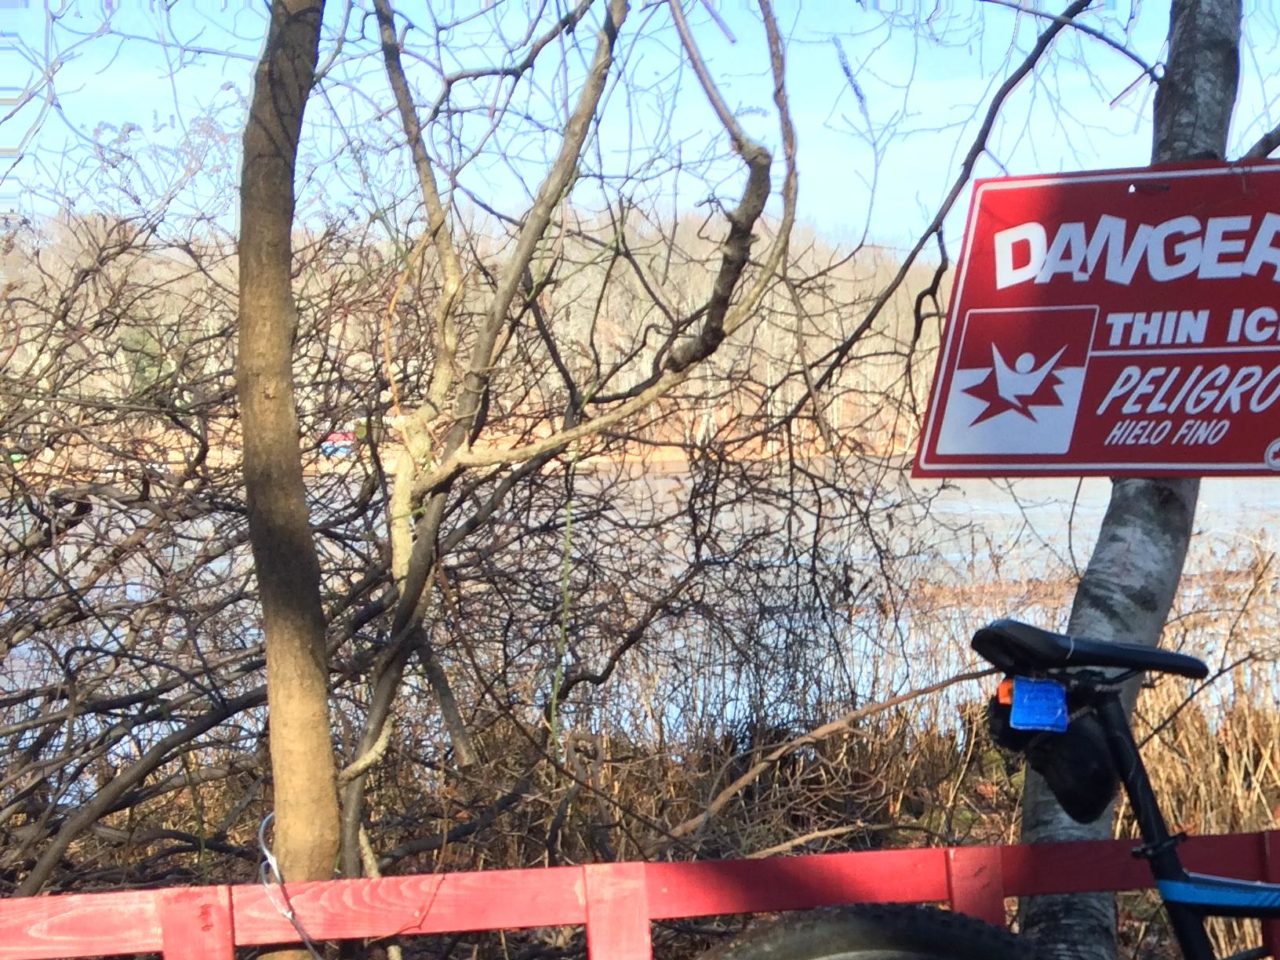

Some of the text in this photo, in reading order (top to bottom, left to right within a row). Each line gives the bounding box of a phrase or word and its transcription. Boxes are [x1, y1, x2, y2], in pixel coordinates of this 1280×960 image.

[1107, 310, 1209, 346] THIN
[1104, 419, 1230, 446] HIELO FINO
